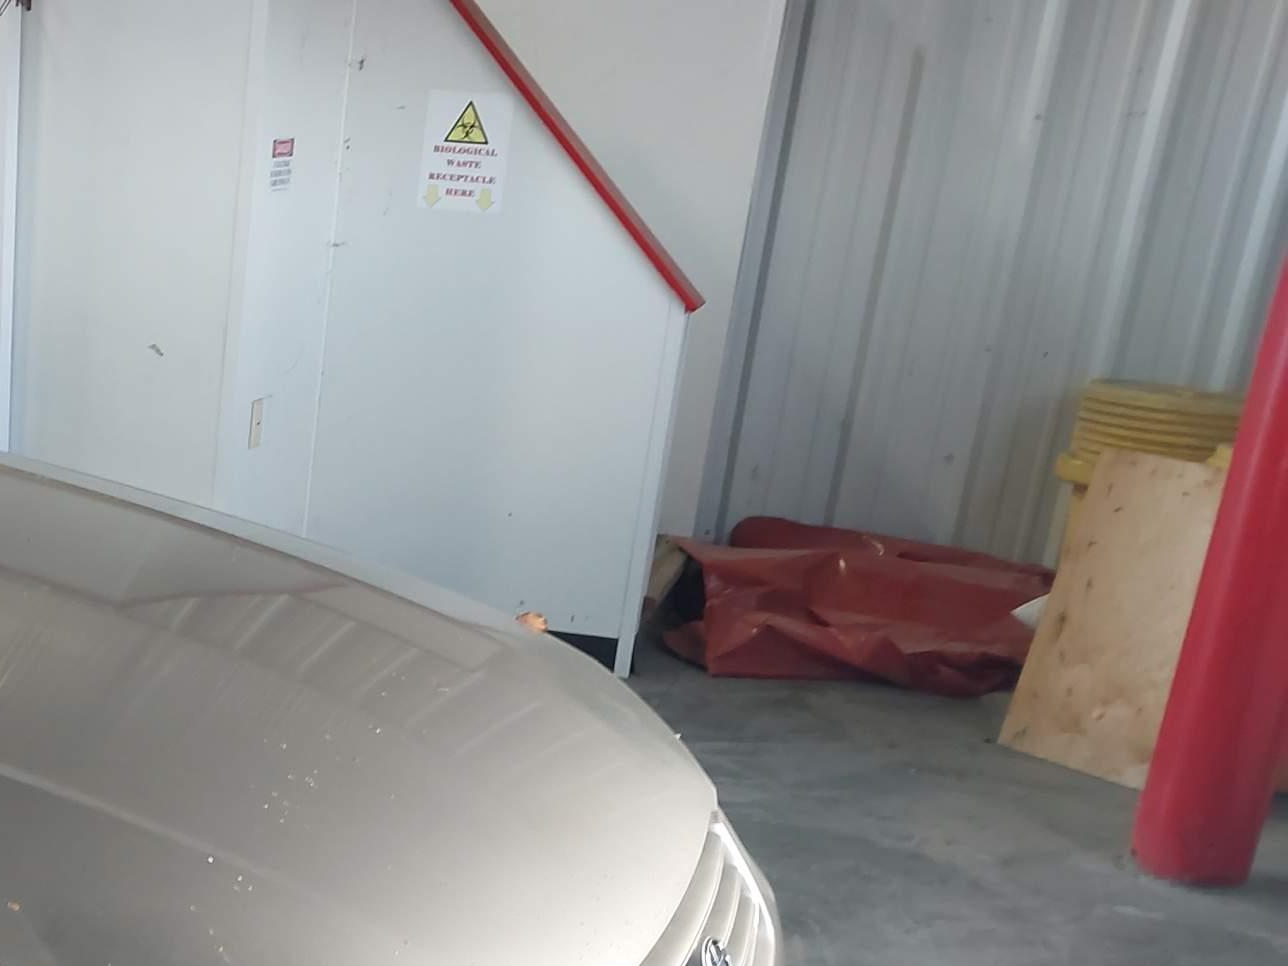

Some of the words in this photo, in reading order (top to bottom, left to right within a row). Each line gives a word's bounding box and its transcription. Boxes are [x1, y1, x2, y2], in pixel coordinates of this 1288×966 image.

[433, 145, 498, 157] BIOLOGICAL
[447, 159, 481, 169] WASTE
[428, 172, 496, 184] RECEPTACLE
[445, 187, 475, 197] HERE
